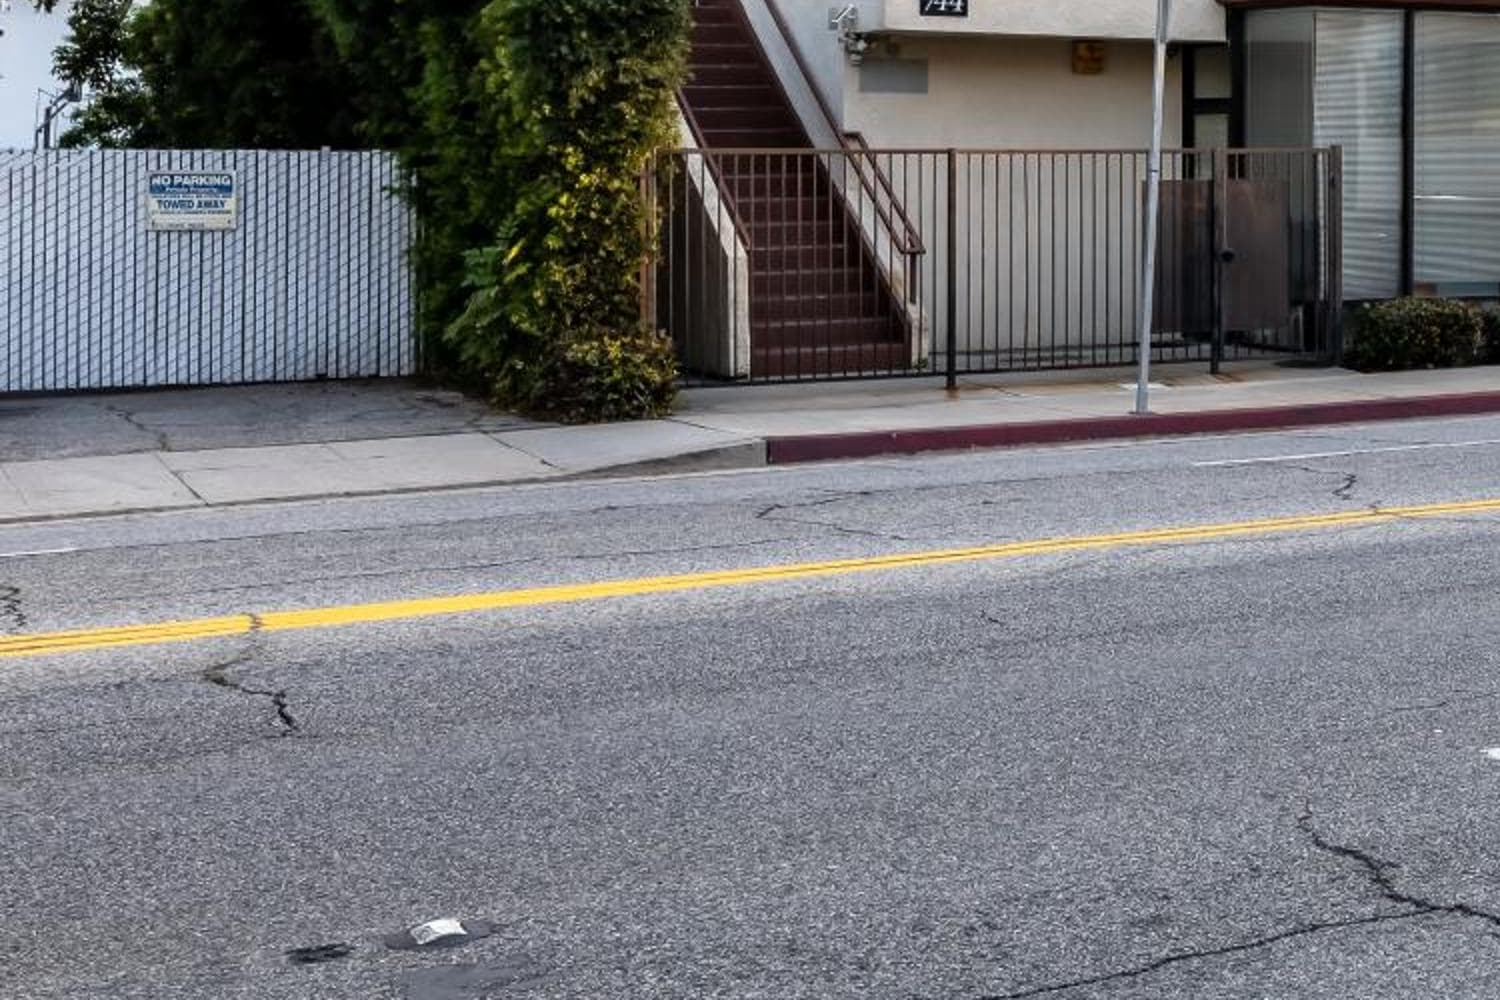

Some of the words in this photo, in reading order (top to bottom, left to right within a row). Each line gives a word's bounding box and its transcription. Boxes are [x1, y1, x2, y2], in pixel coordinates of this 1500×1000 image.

[152, 175, 171, 185] NO
[173, 175, 231, 185] PARKING
[158, 199, 195, 209] TOWED
[197, 199, 225, 209] AWAY
